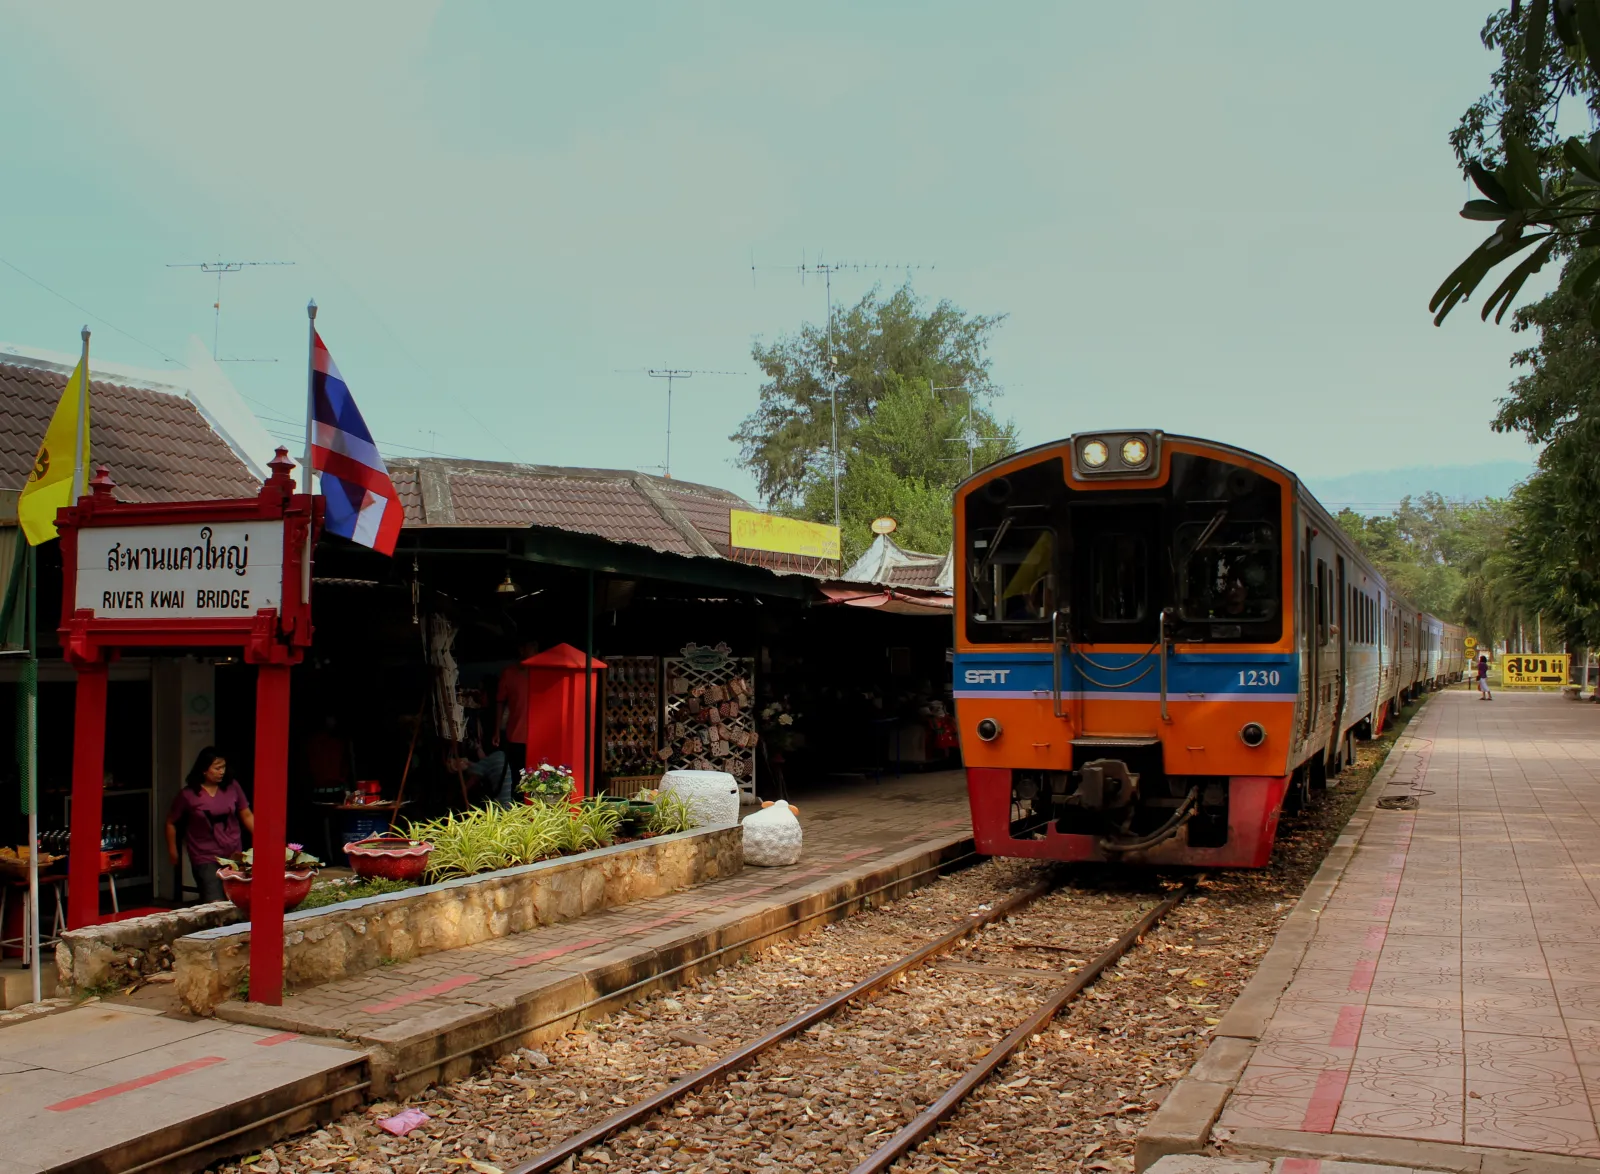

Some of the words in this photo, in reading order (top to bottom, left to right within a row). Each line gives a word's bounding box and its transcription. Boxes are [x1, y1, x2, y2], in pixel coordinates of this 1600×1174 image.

[107, 526, 249, 576] สะพานแควใหญ่
[102, 590, 144, 609] RIVER
[150, 590, 185, 609] KWAI
[196, 589, 250, 609] BRIDGE
[964, 669, 1011, 684] SRT
[1238, 670, 1280, 686] 1230
